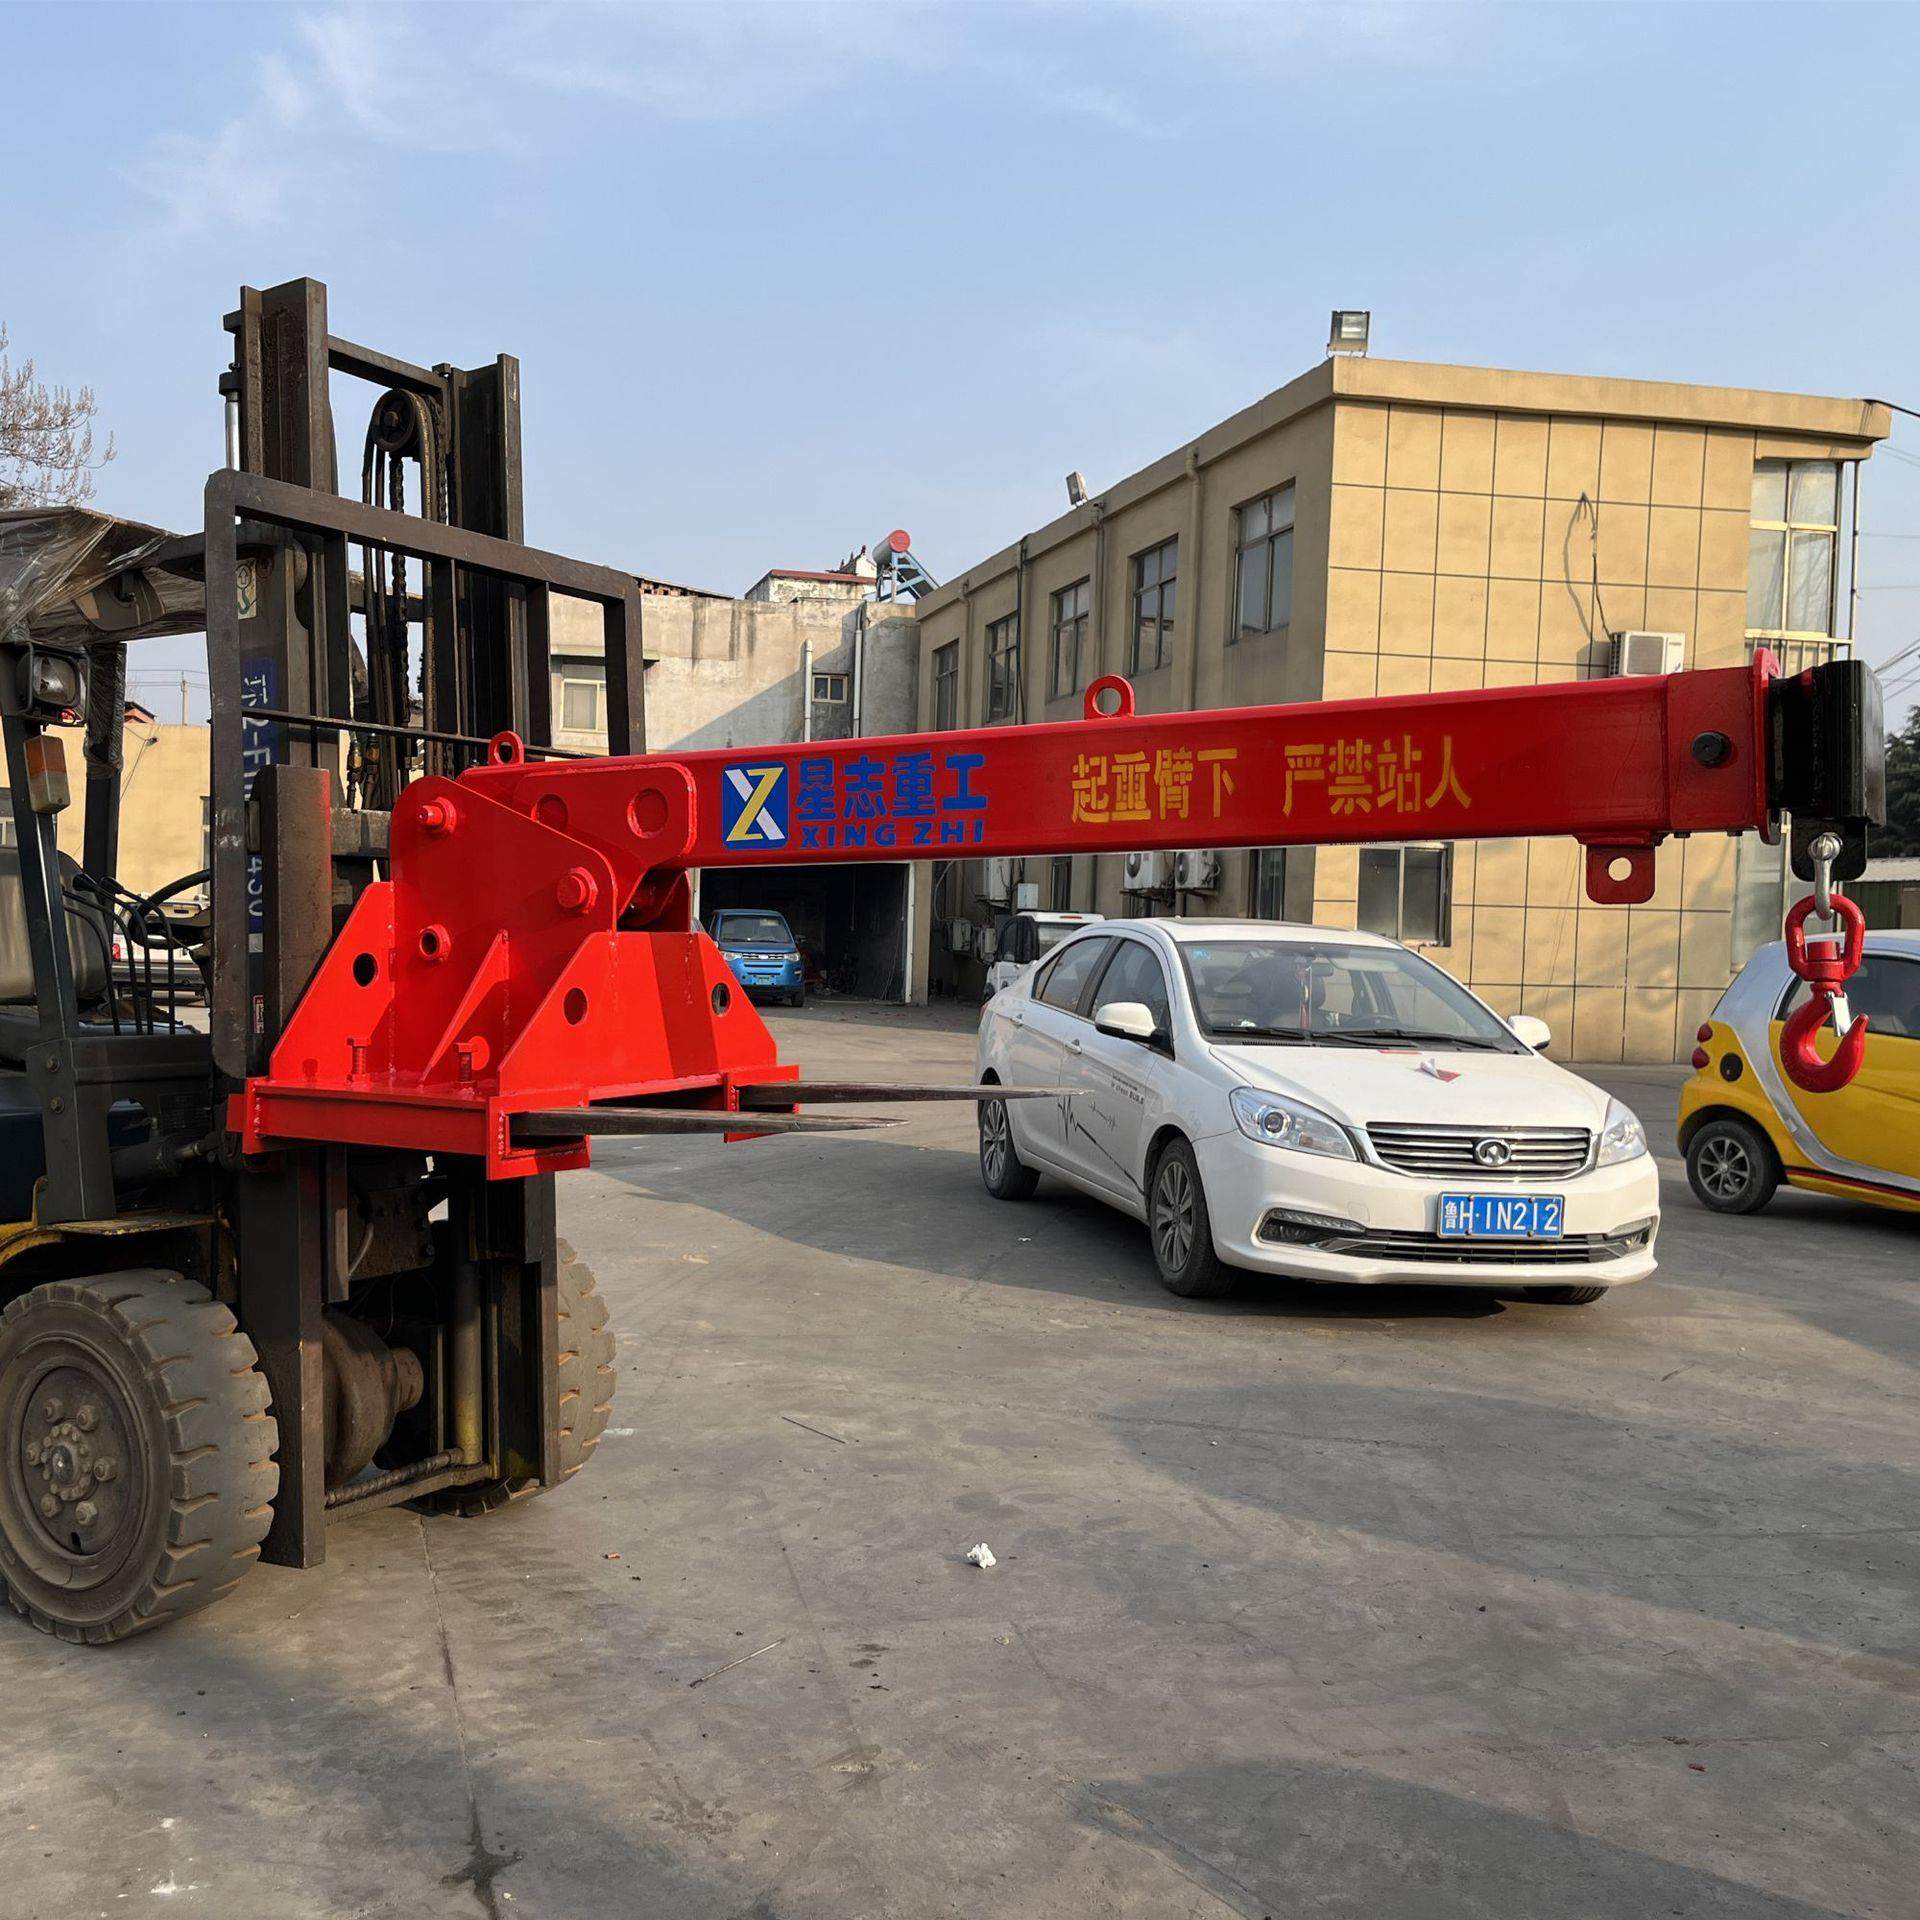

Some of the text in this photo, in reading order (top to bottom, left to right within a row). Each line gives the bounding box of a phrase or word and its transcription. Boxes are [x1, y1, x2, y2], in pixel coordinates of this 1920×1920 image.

[797, 752, 988, 821] 星志重工
[1071, 734, 1472, 824] 起重臂下 严禁站人
[801, 819, 984, 848] XING ZHI
